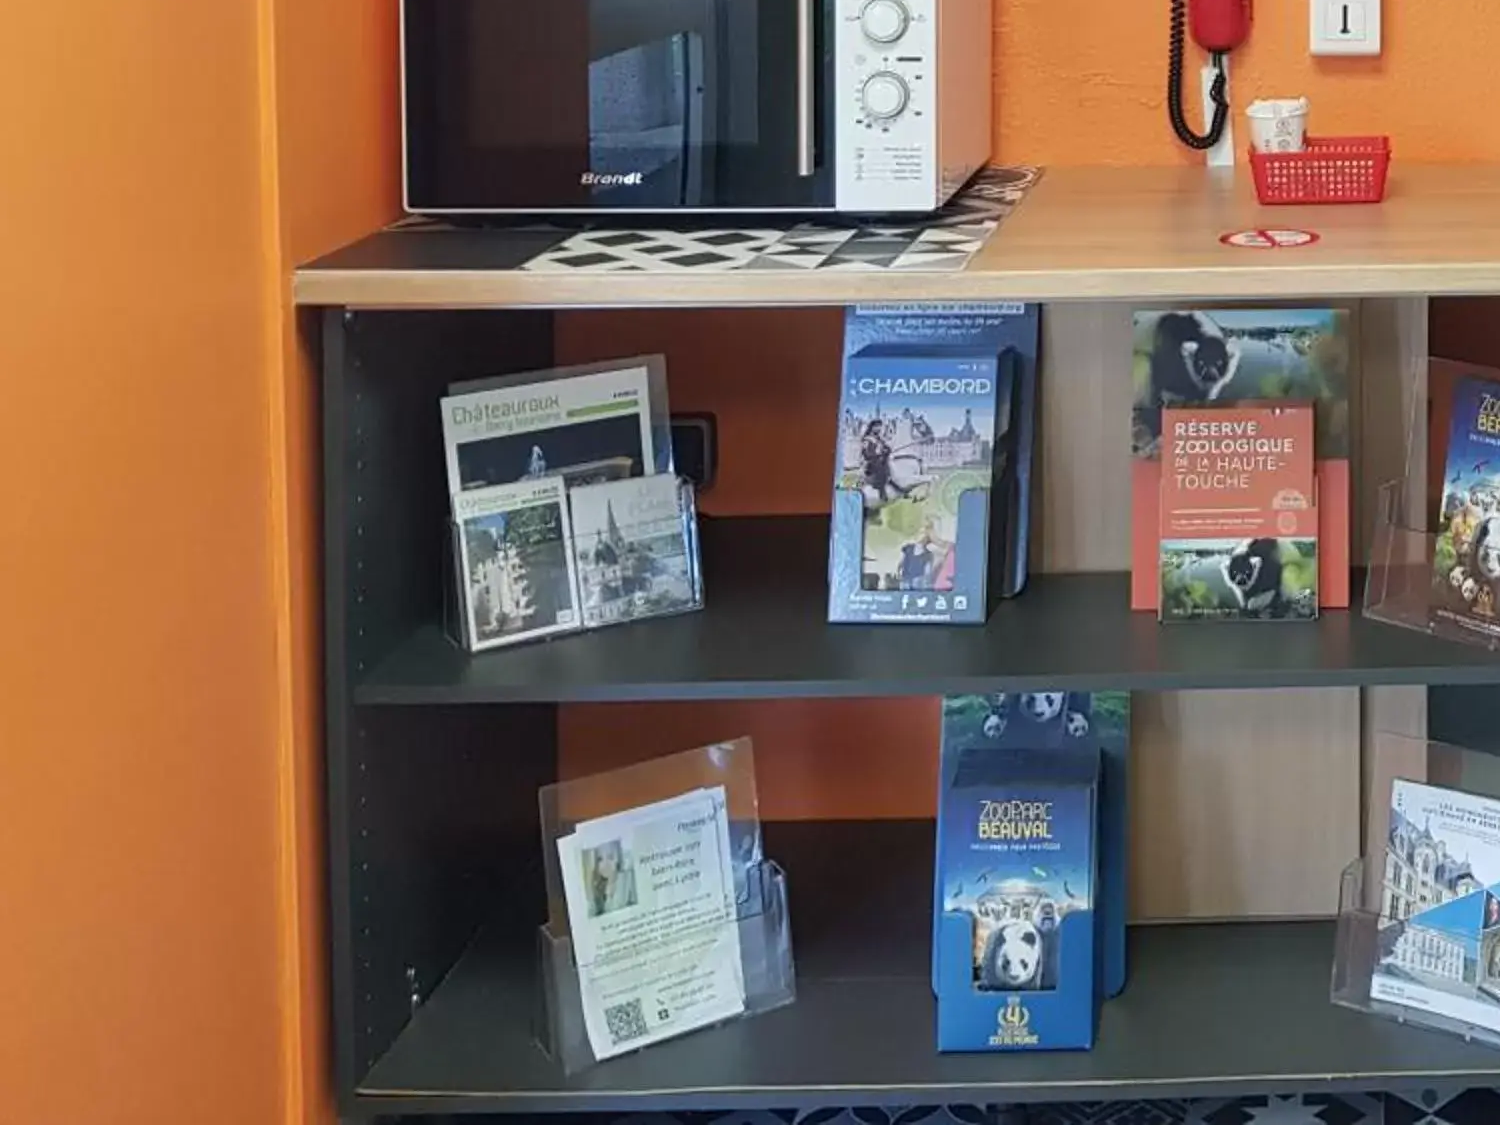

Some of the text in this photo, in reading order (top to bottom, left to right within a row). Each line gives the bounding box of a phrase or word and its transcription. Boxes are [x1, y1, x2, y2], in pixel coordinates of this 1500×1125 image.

[581, 172, 643, 184] Brandt
[858, 378, 991, 395] CHAMBORD
[451, 394, 560, 426] Châteauroux
[1174, 418, 1257, 436] RÉSERVE
[1174, 438, 1295, 454] ZOOLOGIQUE
[1196, 456, 1209, 468] LA
[1217, 455, 1287, 471] HAUTE-
[1175, 474, 1250, 489] TOUCHE
[979, 799, 1053, 820] ZOOPARC
[979, 820, 1053, 841] BEAUVAL
